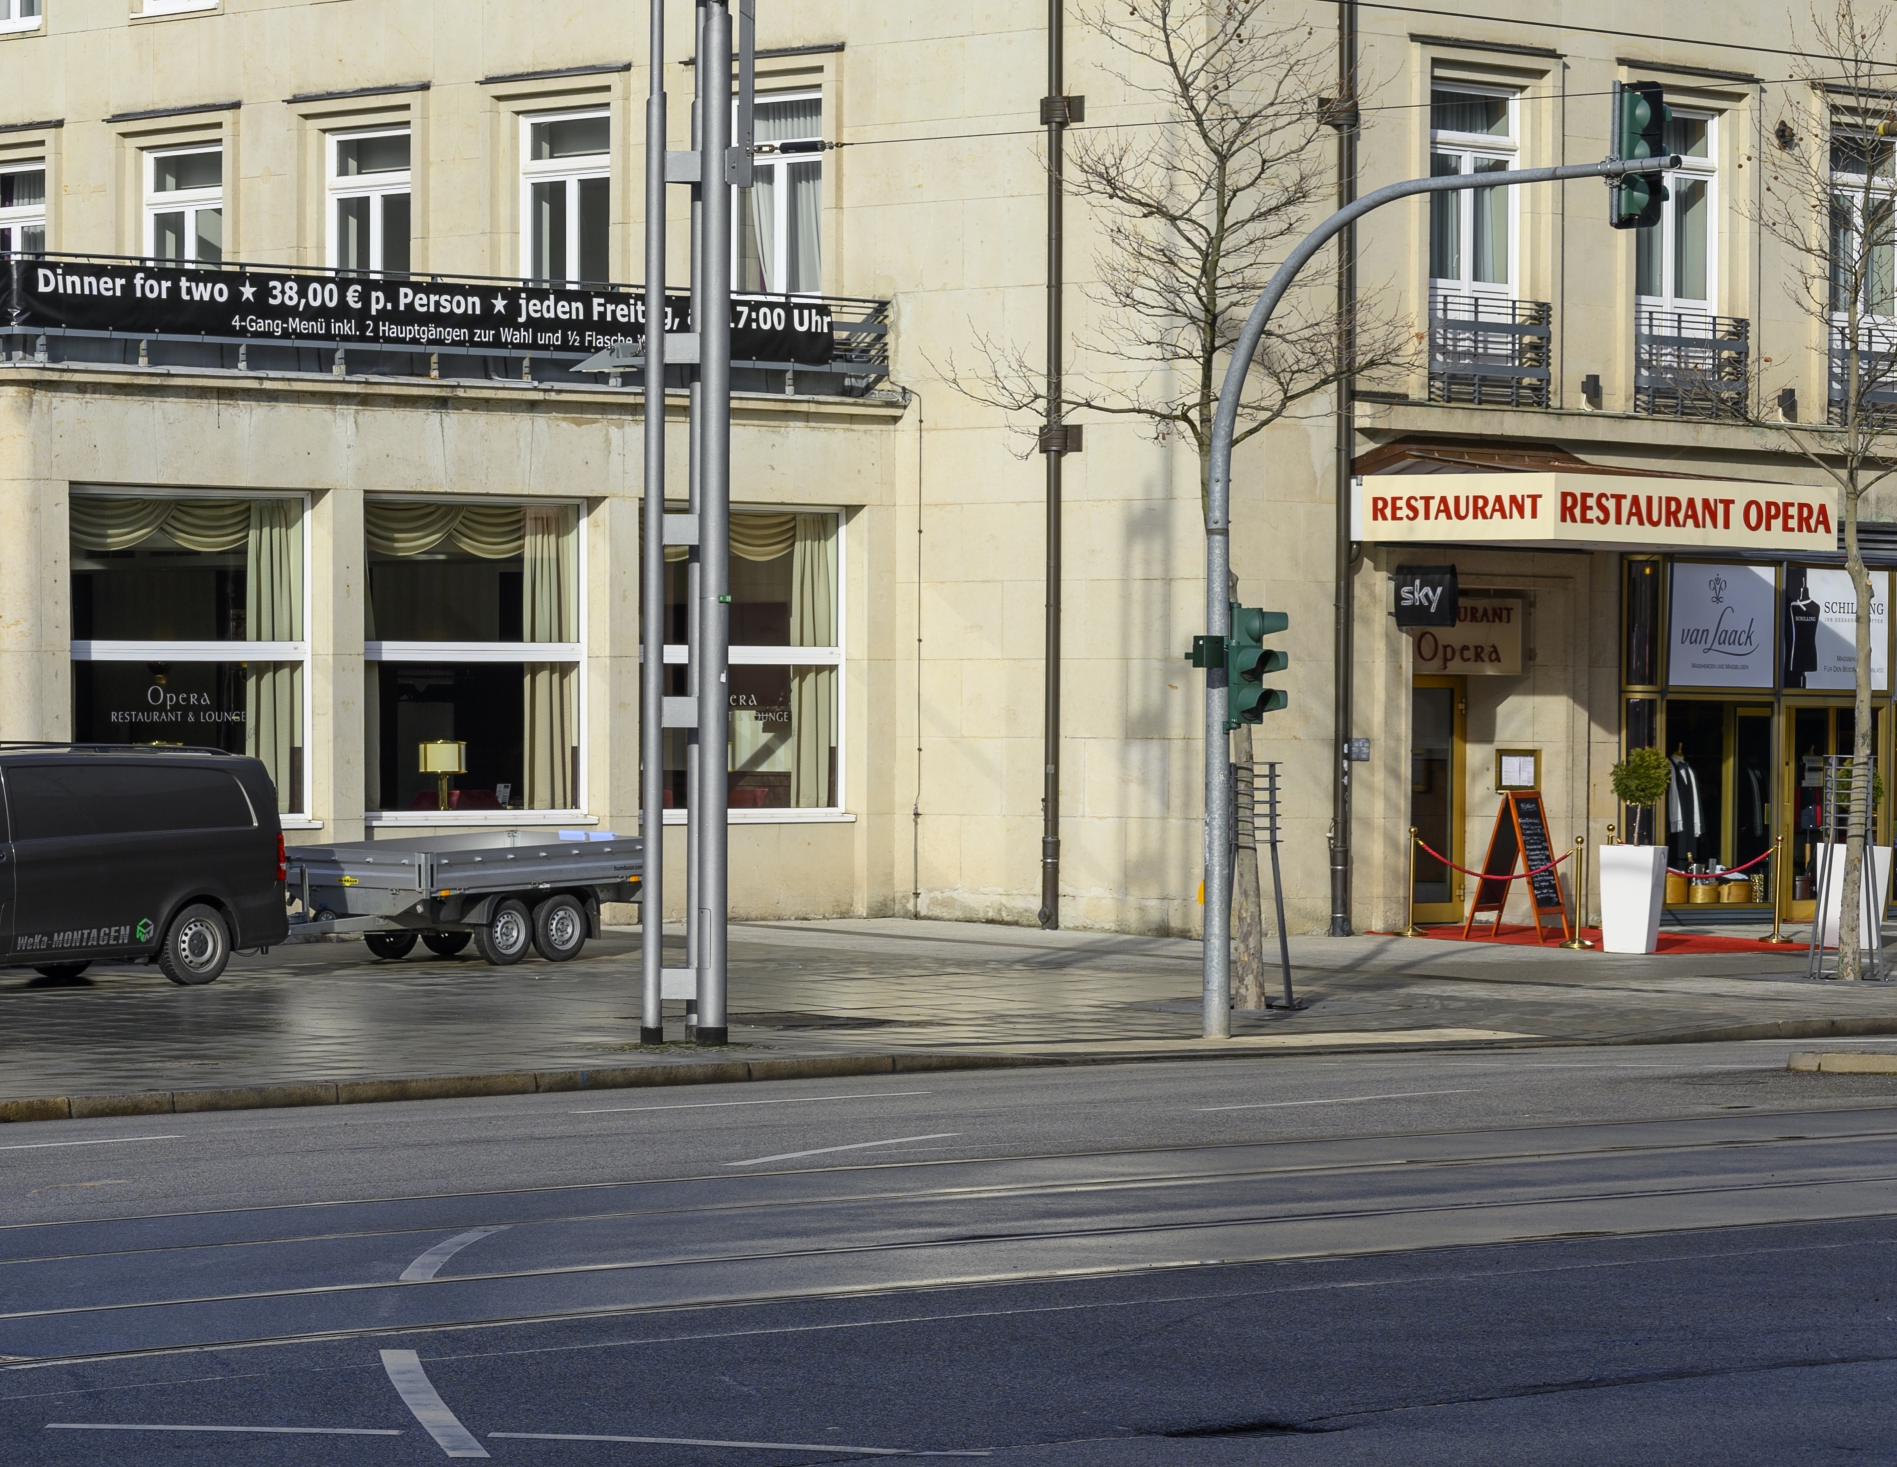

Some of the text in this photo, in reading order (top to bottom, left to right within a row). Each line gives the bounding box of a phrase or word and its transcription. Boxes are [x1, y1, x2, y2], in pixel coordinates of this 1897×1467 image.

[37, 268, 126, 298] Dinner
[133, 272, 176, 299] for
[180, 279, 229, 303] two
[268, 281, 338, 312] 38,00
[345, 284, 362, 308] €
[370, 290, 393, 315] p.
[399, 288, 481, 315] Person
[517, 293, 584, 323] jeden
[592, 298, 680, 330] Freitg,
[730, 305, 786, 331] 7:00
[793, 307, 831, 333] Uhr
[232, 315, 326, 335] 4-Gang-Menü
[331, 319, 360, 336] inkl.
[366, 321, 374, 337] 2
[379, 322, 469, 344] Hauptgängen
[474, 327, 496, 342] zur
[500, 327, 533, 344] Wahl
[537, 329, 561, 345] und
[584, 332, 633, 348] Flasche
[1372, 493, 1543, 522] RESTAURANT
[1560, 490, 1831, 534] RESTAURANT OPERA
[1400, 578, 1443, 612] sky
[1824, 601, 1884, 615] SCHILNG
[1681, 606, 1759, 656] van Laack
[1417, 630, 1502, 671] Opera
[147, 685, 211, 710] Opera
[111, 711, 246, 722] RESTAURANT & LOUNGE
[17, 925, 131, 950] WeKa-MONTAGEN
